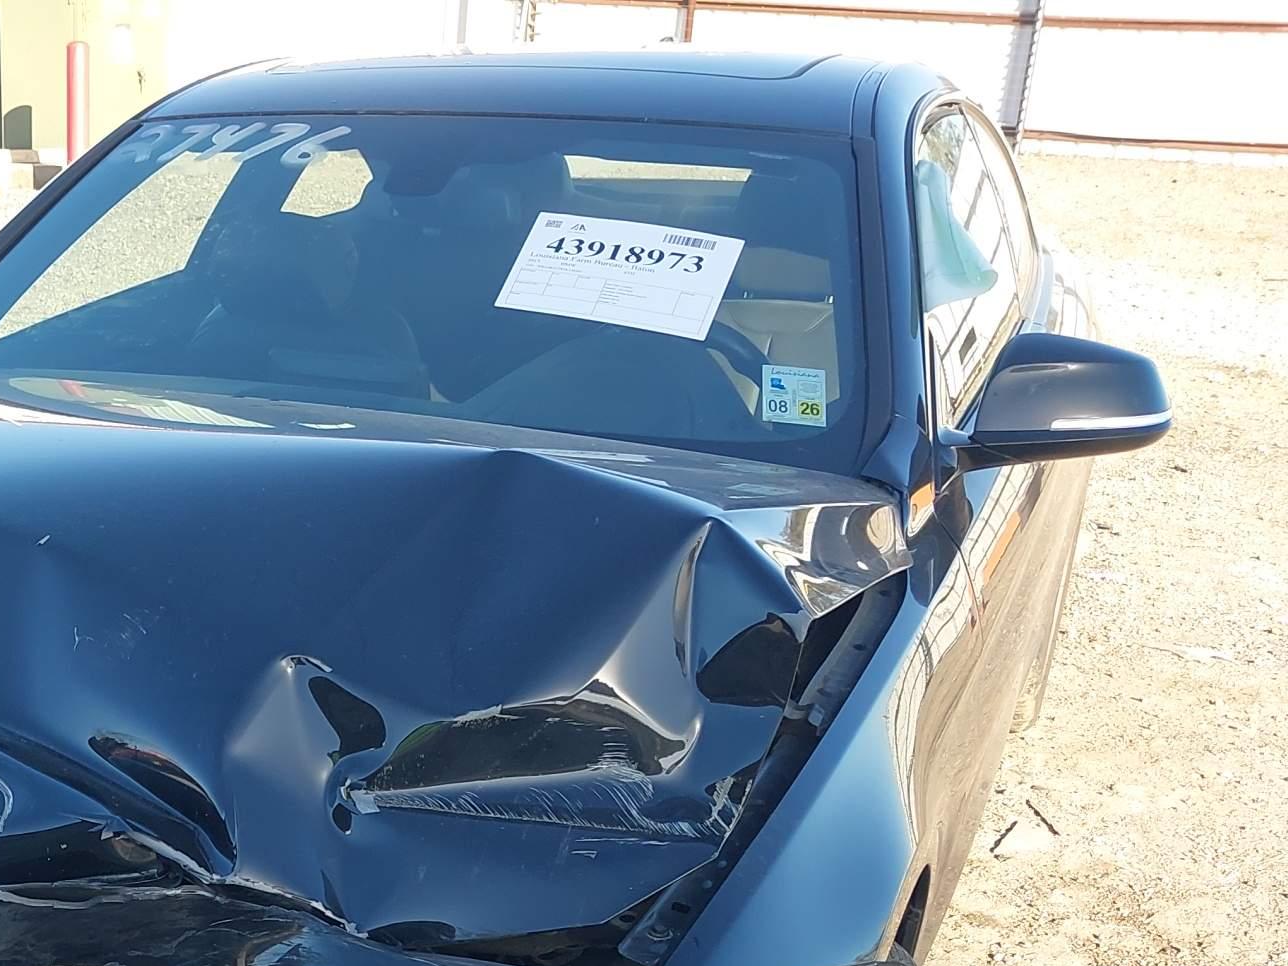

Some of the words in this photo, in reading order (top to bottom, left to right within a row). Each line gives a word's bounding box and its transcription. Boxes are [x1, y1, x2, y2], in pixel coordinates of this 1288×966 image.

[530, 251, 569, 261] Louisiana
[570, 255, 593, 264] Farm
[545, 236, 705, 274] 43918973
[770, 367, 820, 378] Louisiana
[768, 399, 788, 413] 08
[799, 402, 821, 416] 26
